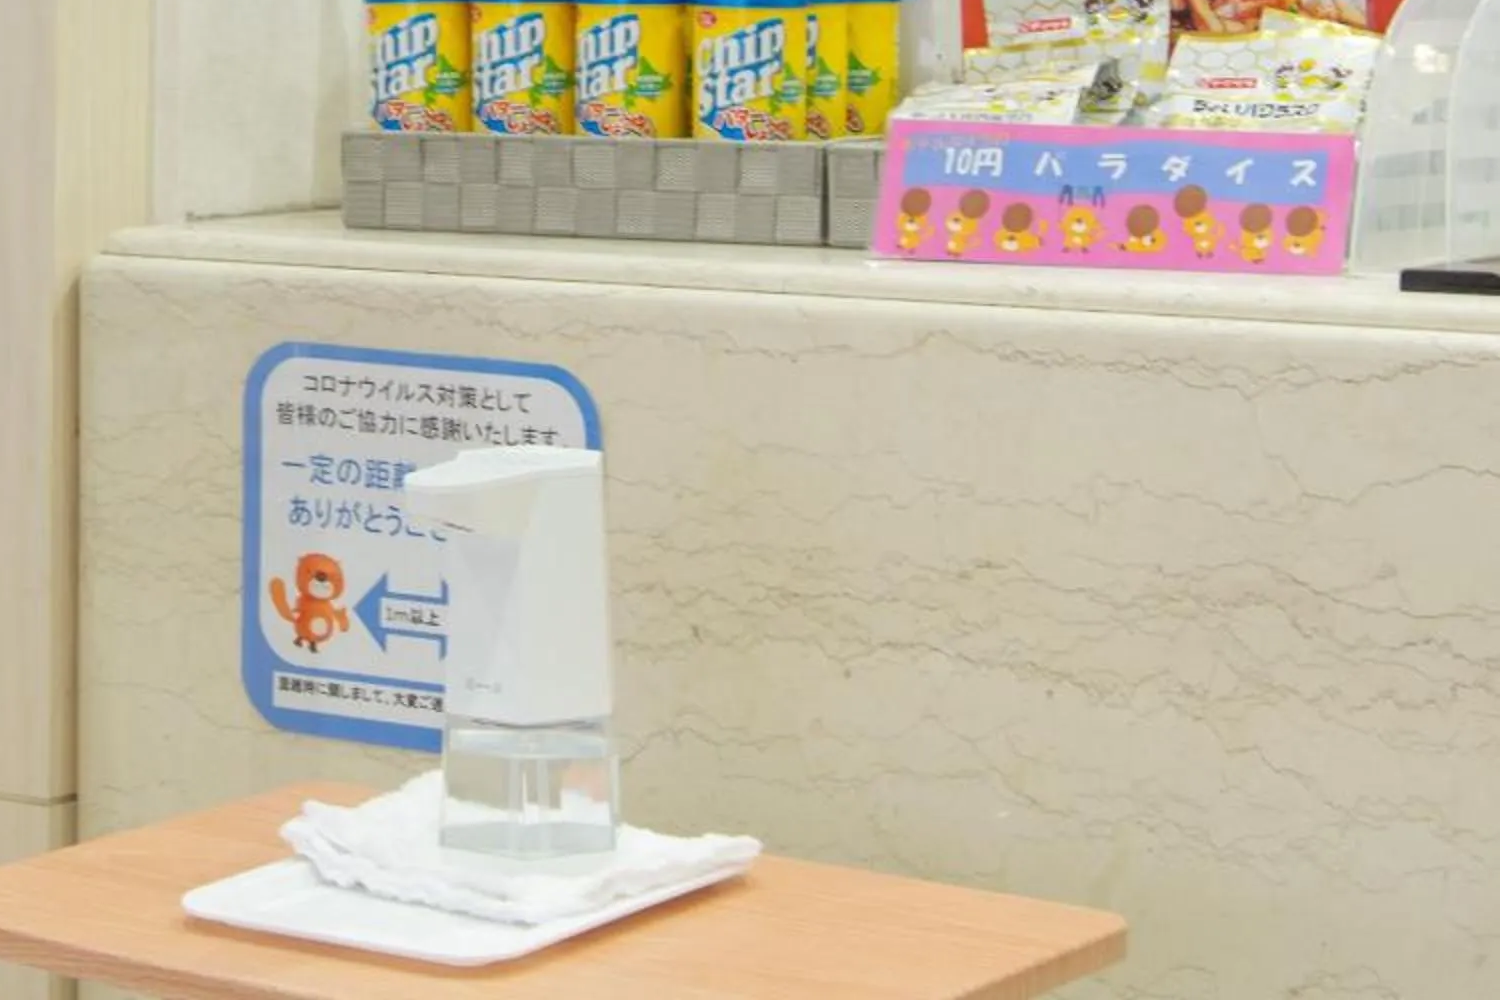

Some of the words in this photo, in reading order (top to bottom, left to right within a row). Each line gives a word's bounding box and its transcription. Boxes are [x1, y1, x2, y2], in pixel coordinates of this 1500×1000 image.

[943, 147, 1004, 177] 10円
[303, 374, 532, 415] コロナウイルス対策として
